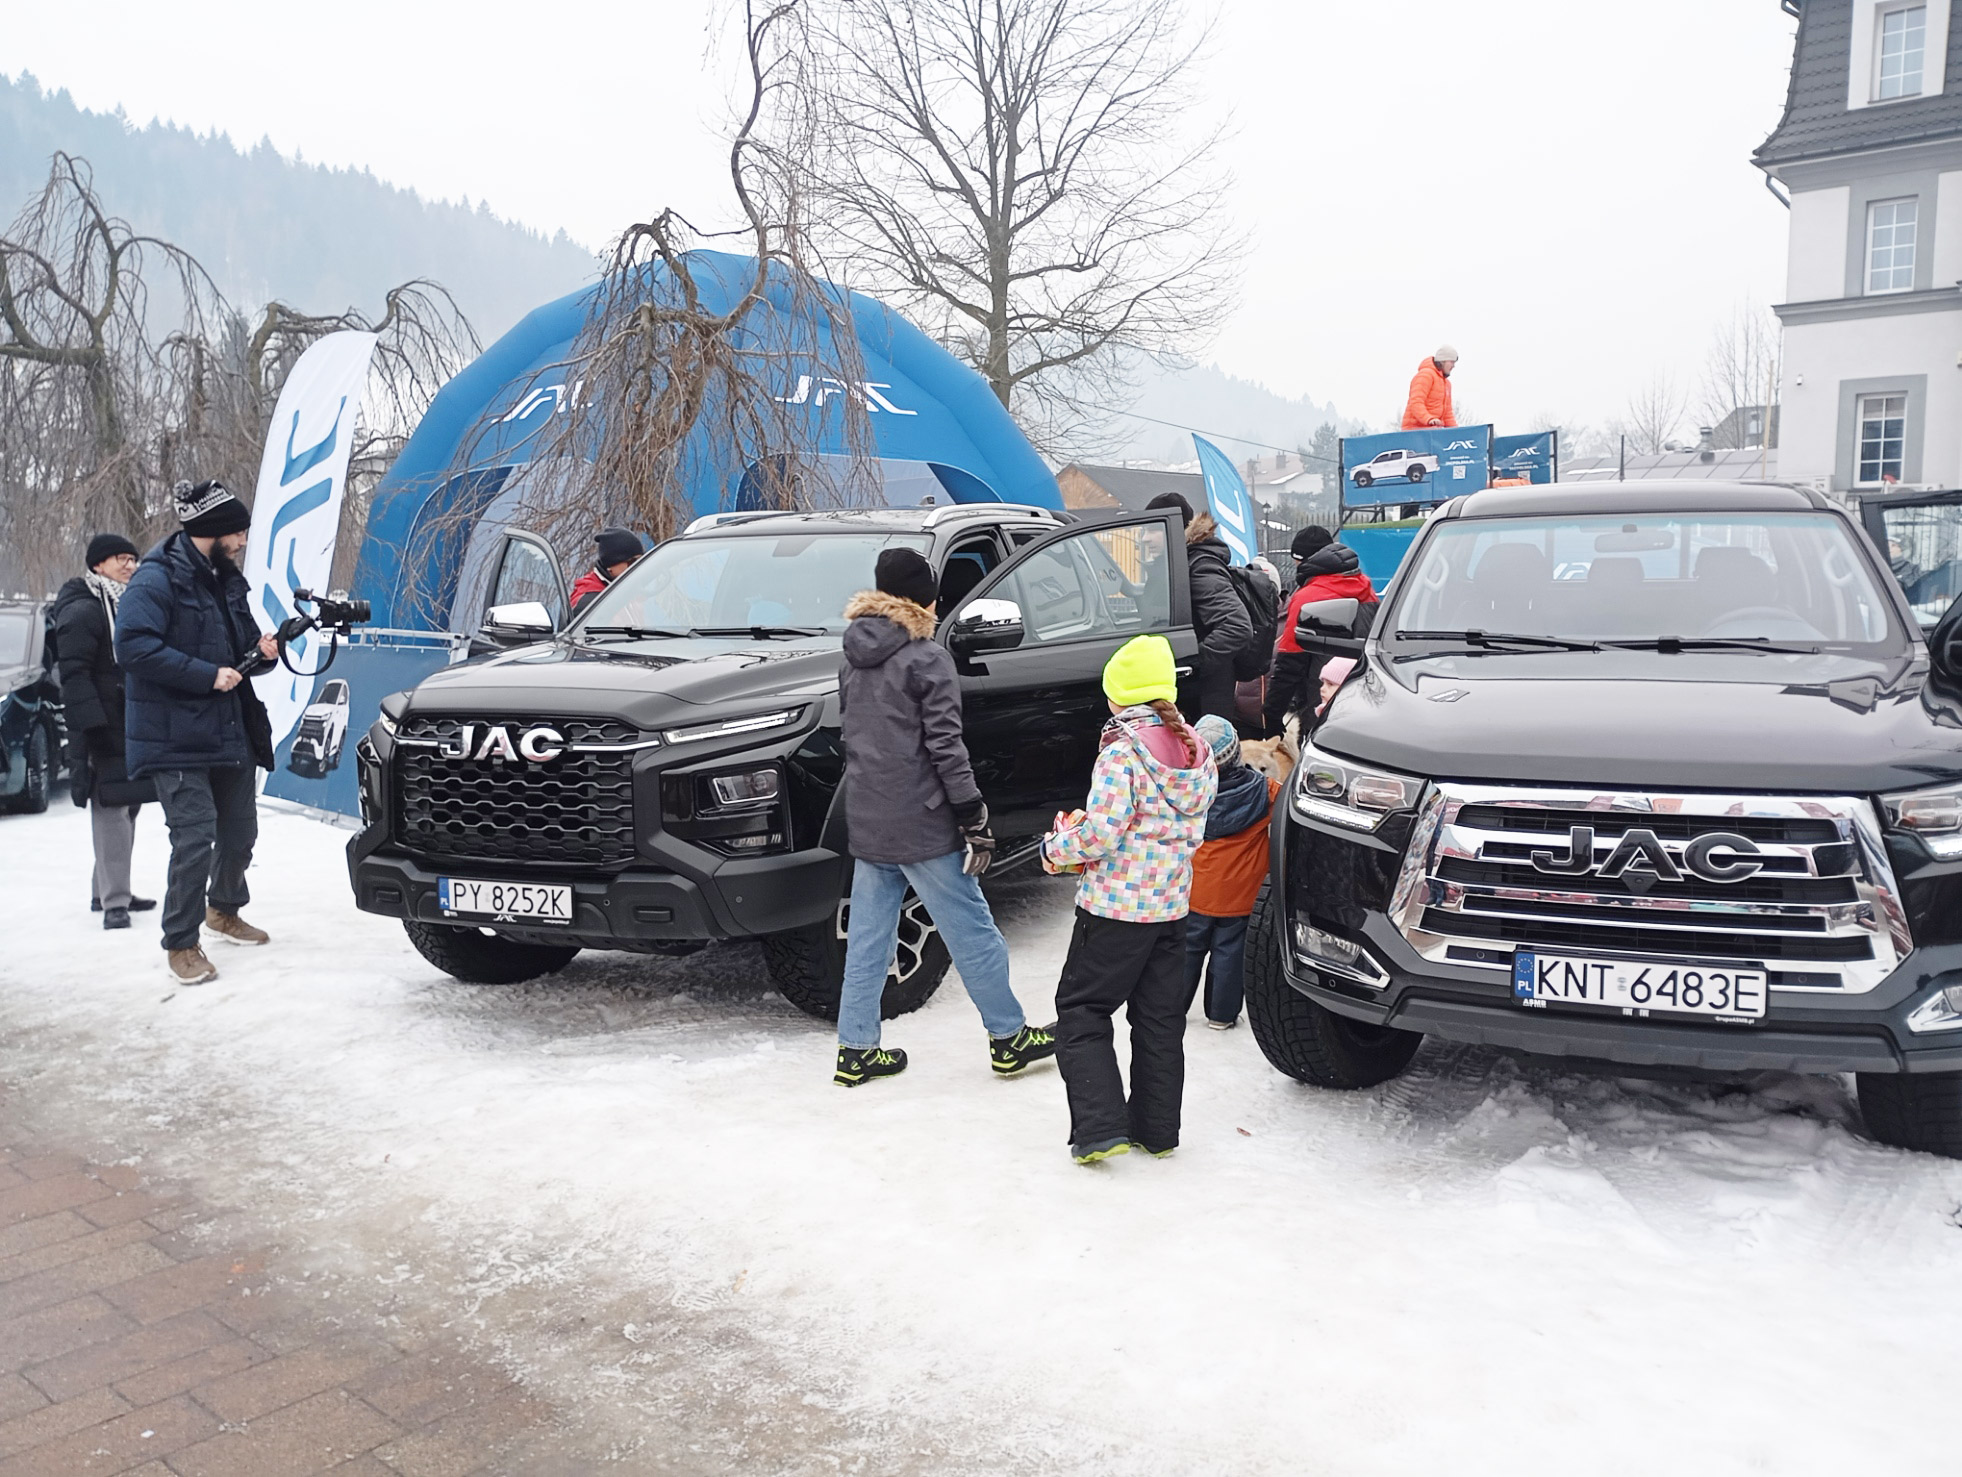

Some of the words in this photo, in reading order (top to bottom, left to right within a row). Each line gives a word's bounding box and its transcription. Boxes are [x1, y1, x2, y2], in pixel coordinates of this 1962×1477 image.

[774, 374, 919, 416] JAC
[1443, 440, 1478, 451] JAC
[1508, 447, 1540, 458] JAC
[439, 724, 565, 763] JAC
[1530, 825, 1765, 884] JAC
[453, 882, 482, 910] PY
[491, 885, 566, 917] 8252K
[1517, 979, 1533, 992] PL
[1538, 959, 1614, 1000] KNT
[1631, 968, 1760, 1012] 6483E
